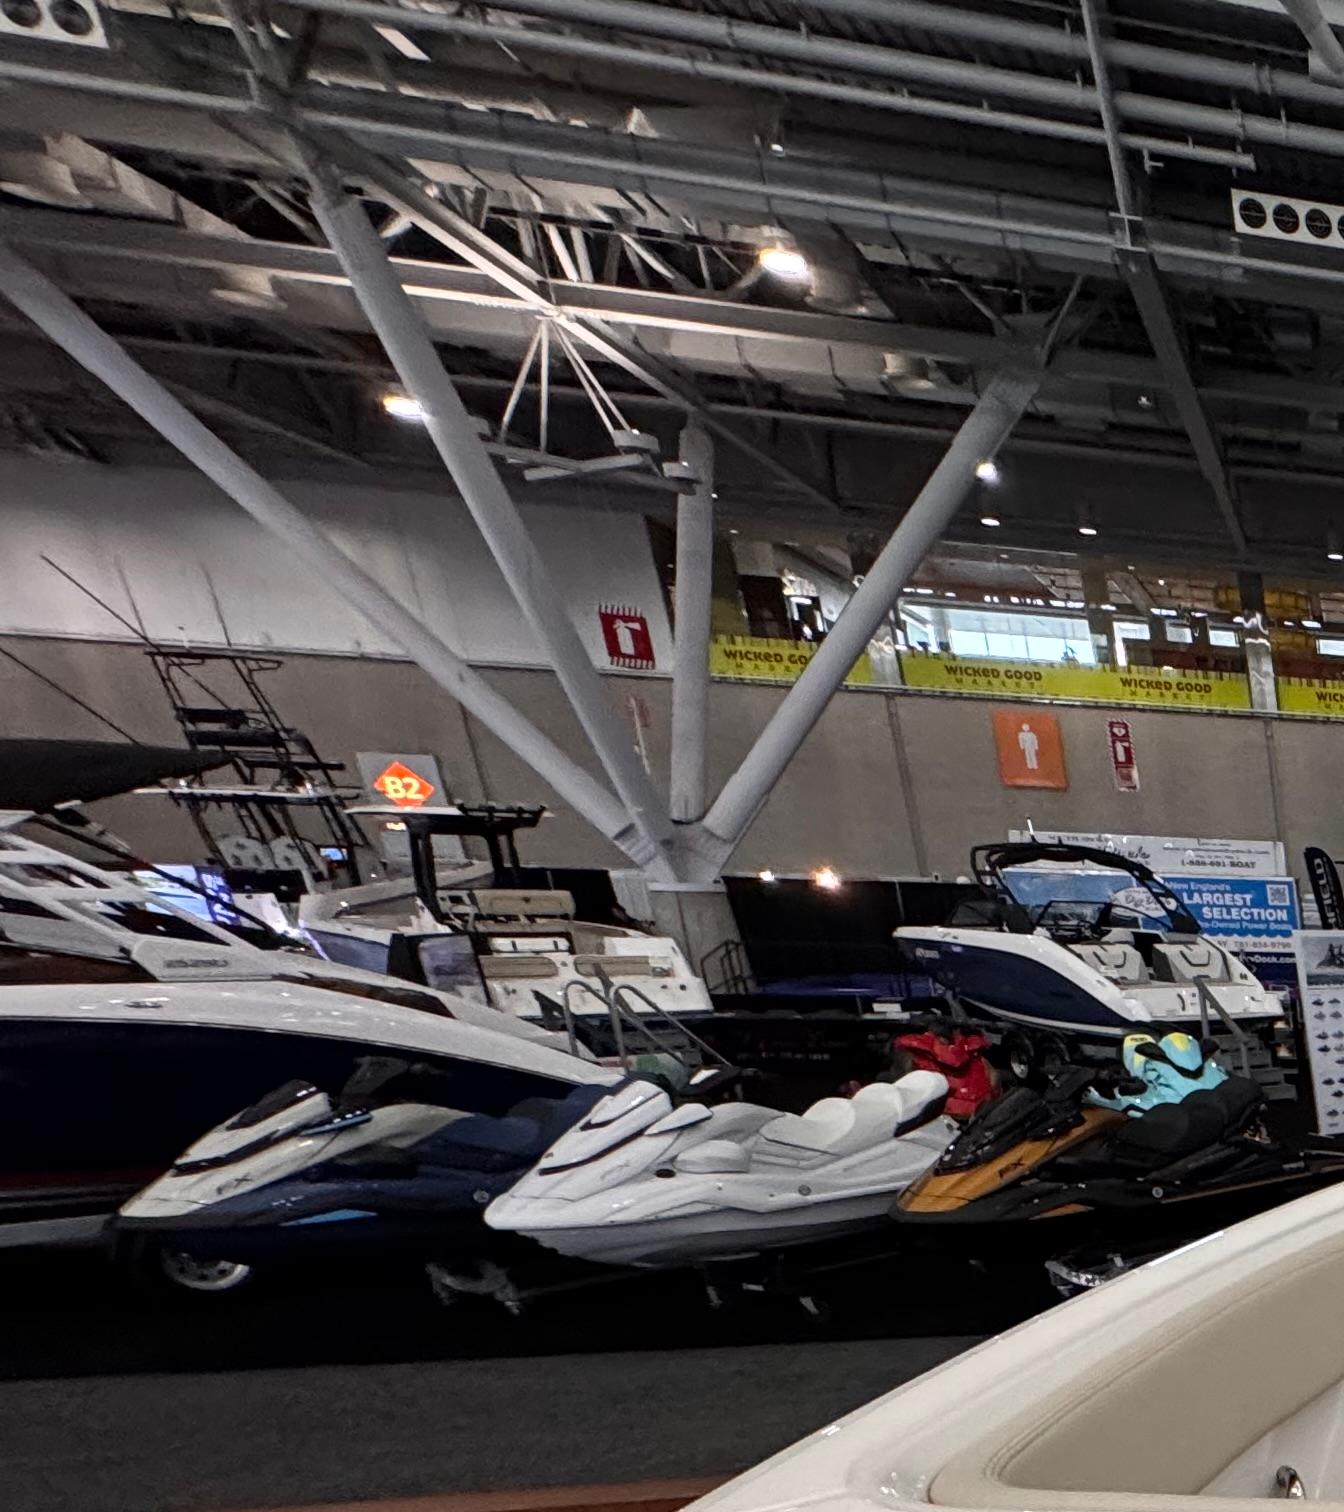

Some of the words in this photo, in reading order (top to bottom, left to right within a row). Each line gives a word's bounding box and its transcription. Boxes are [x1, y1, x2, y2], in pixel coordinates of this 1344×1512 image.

[787, 654, 808, 666] GO
[1004, 669, 1042, 682] GOOD
[1176, 681, 1212, 694] GOOD
[383, 776, 424, 799] B2
[1182, 892, 1253, 906] LARGEST
[1202, 907, 1288, 921] SELECTION
